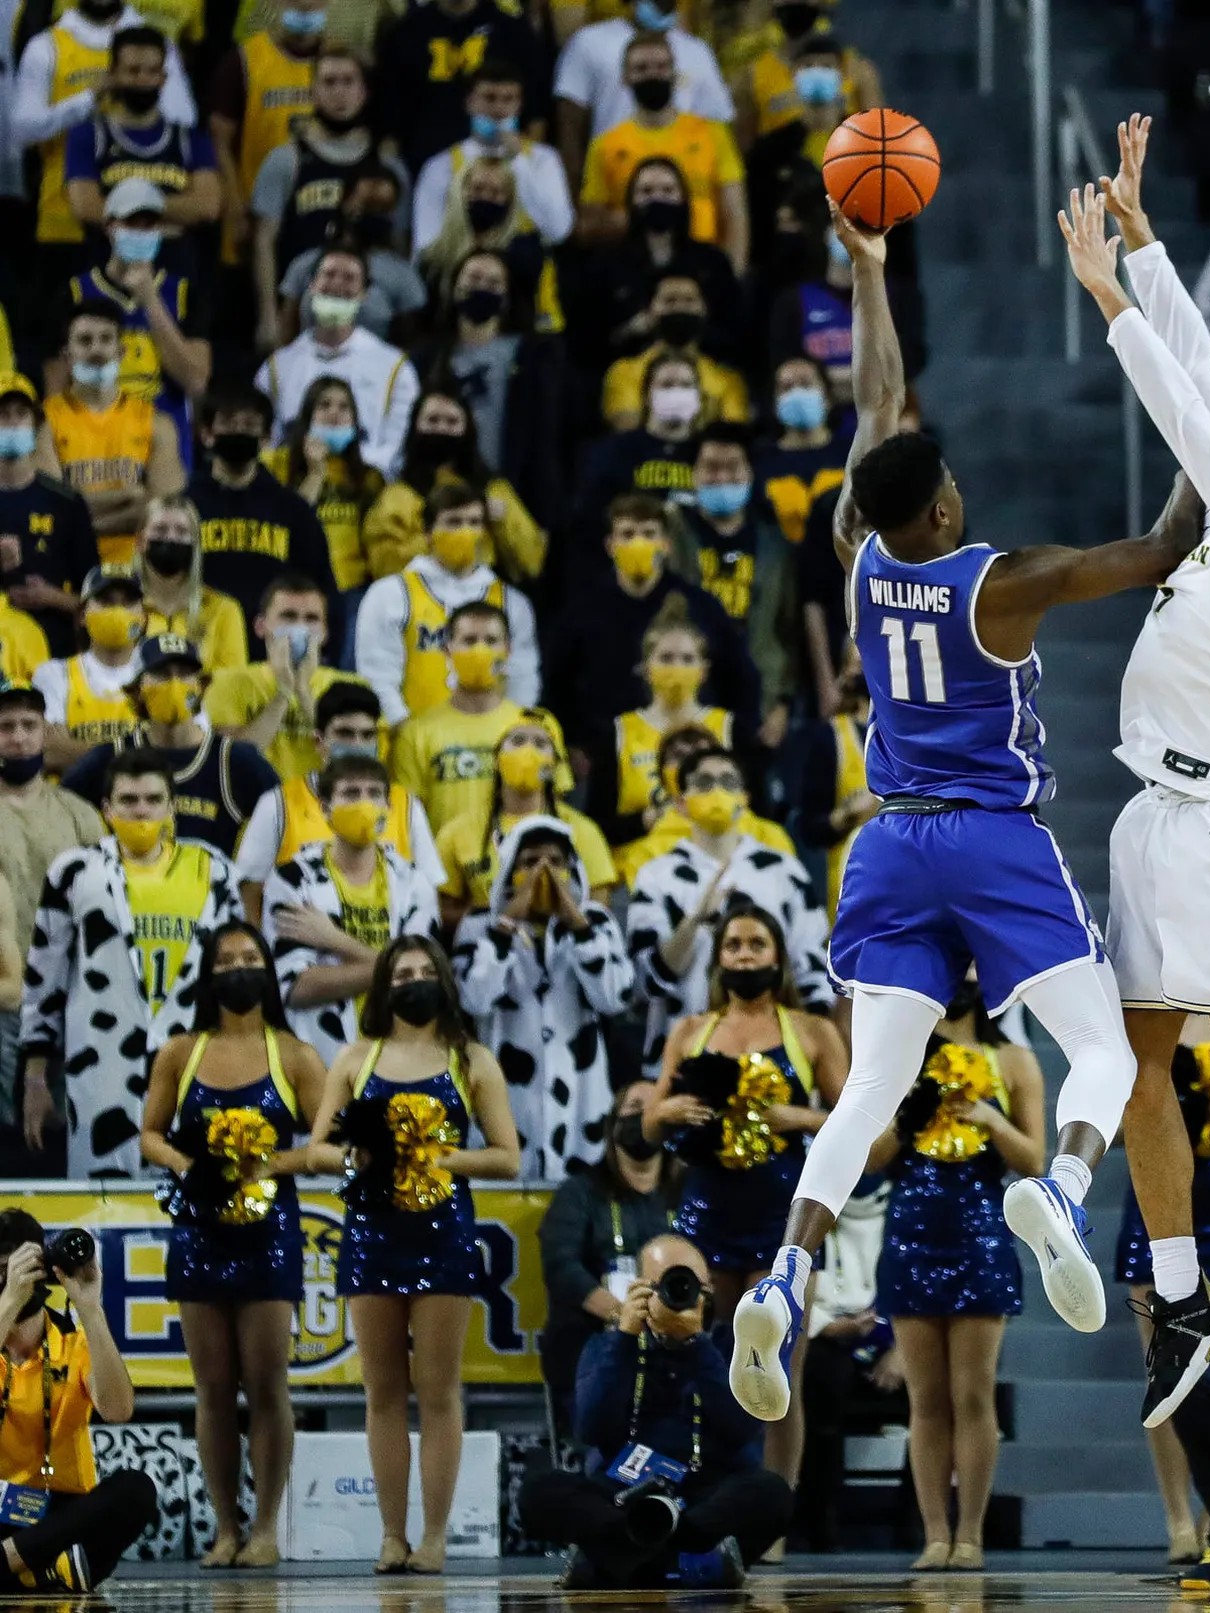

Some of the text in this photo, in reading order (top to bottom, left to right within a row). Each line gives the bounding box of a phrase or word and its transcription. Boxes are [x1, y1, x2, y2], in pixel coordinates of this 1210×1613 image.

[199, 517, 290, 562] ICHIGAN
[868, 577, 951, 613] WILLIAMS
[880, 616, 946, 703] 11
[148, 948, 168, 1001] 1
[335, 1478, 377, 1495] GILD
